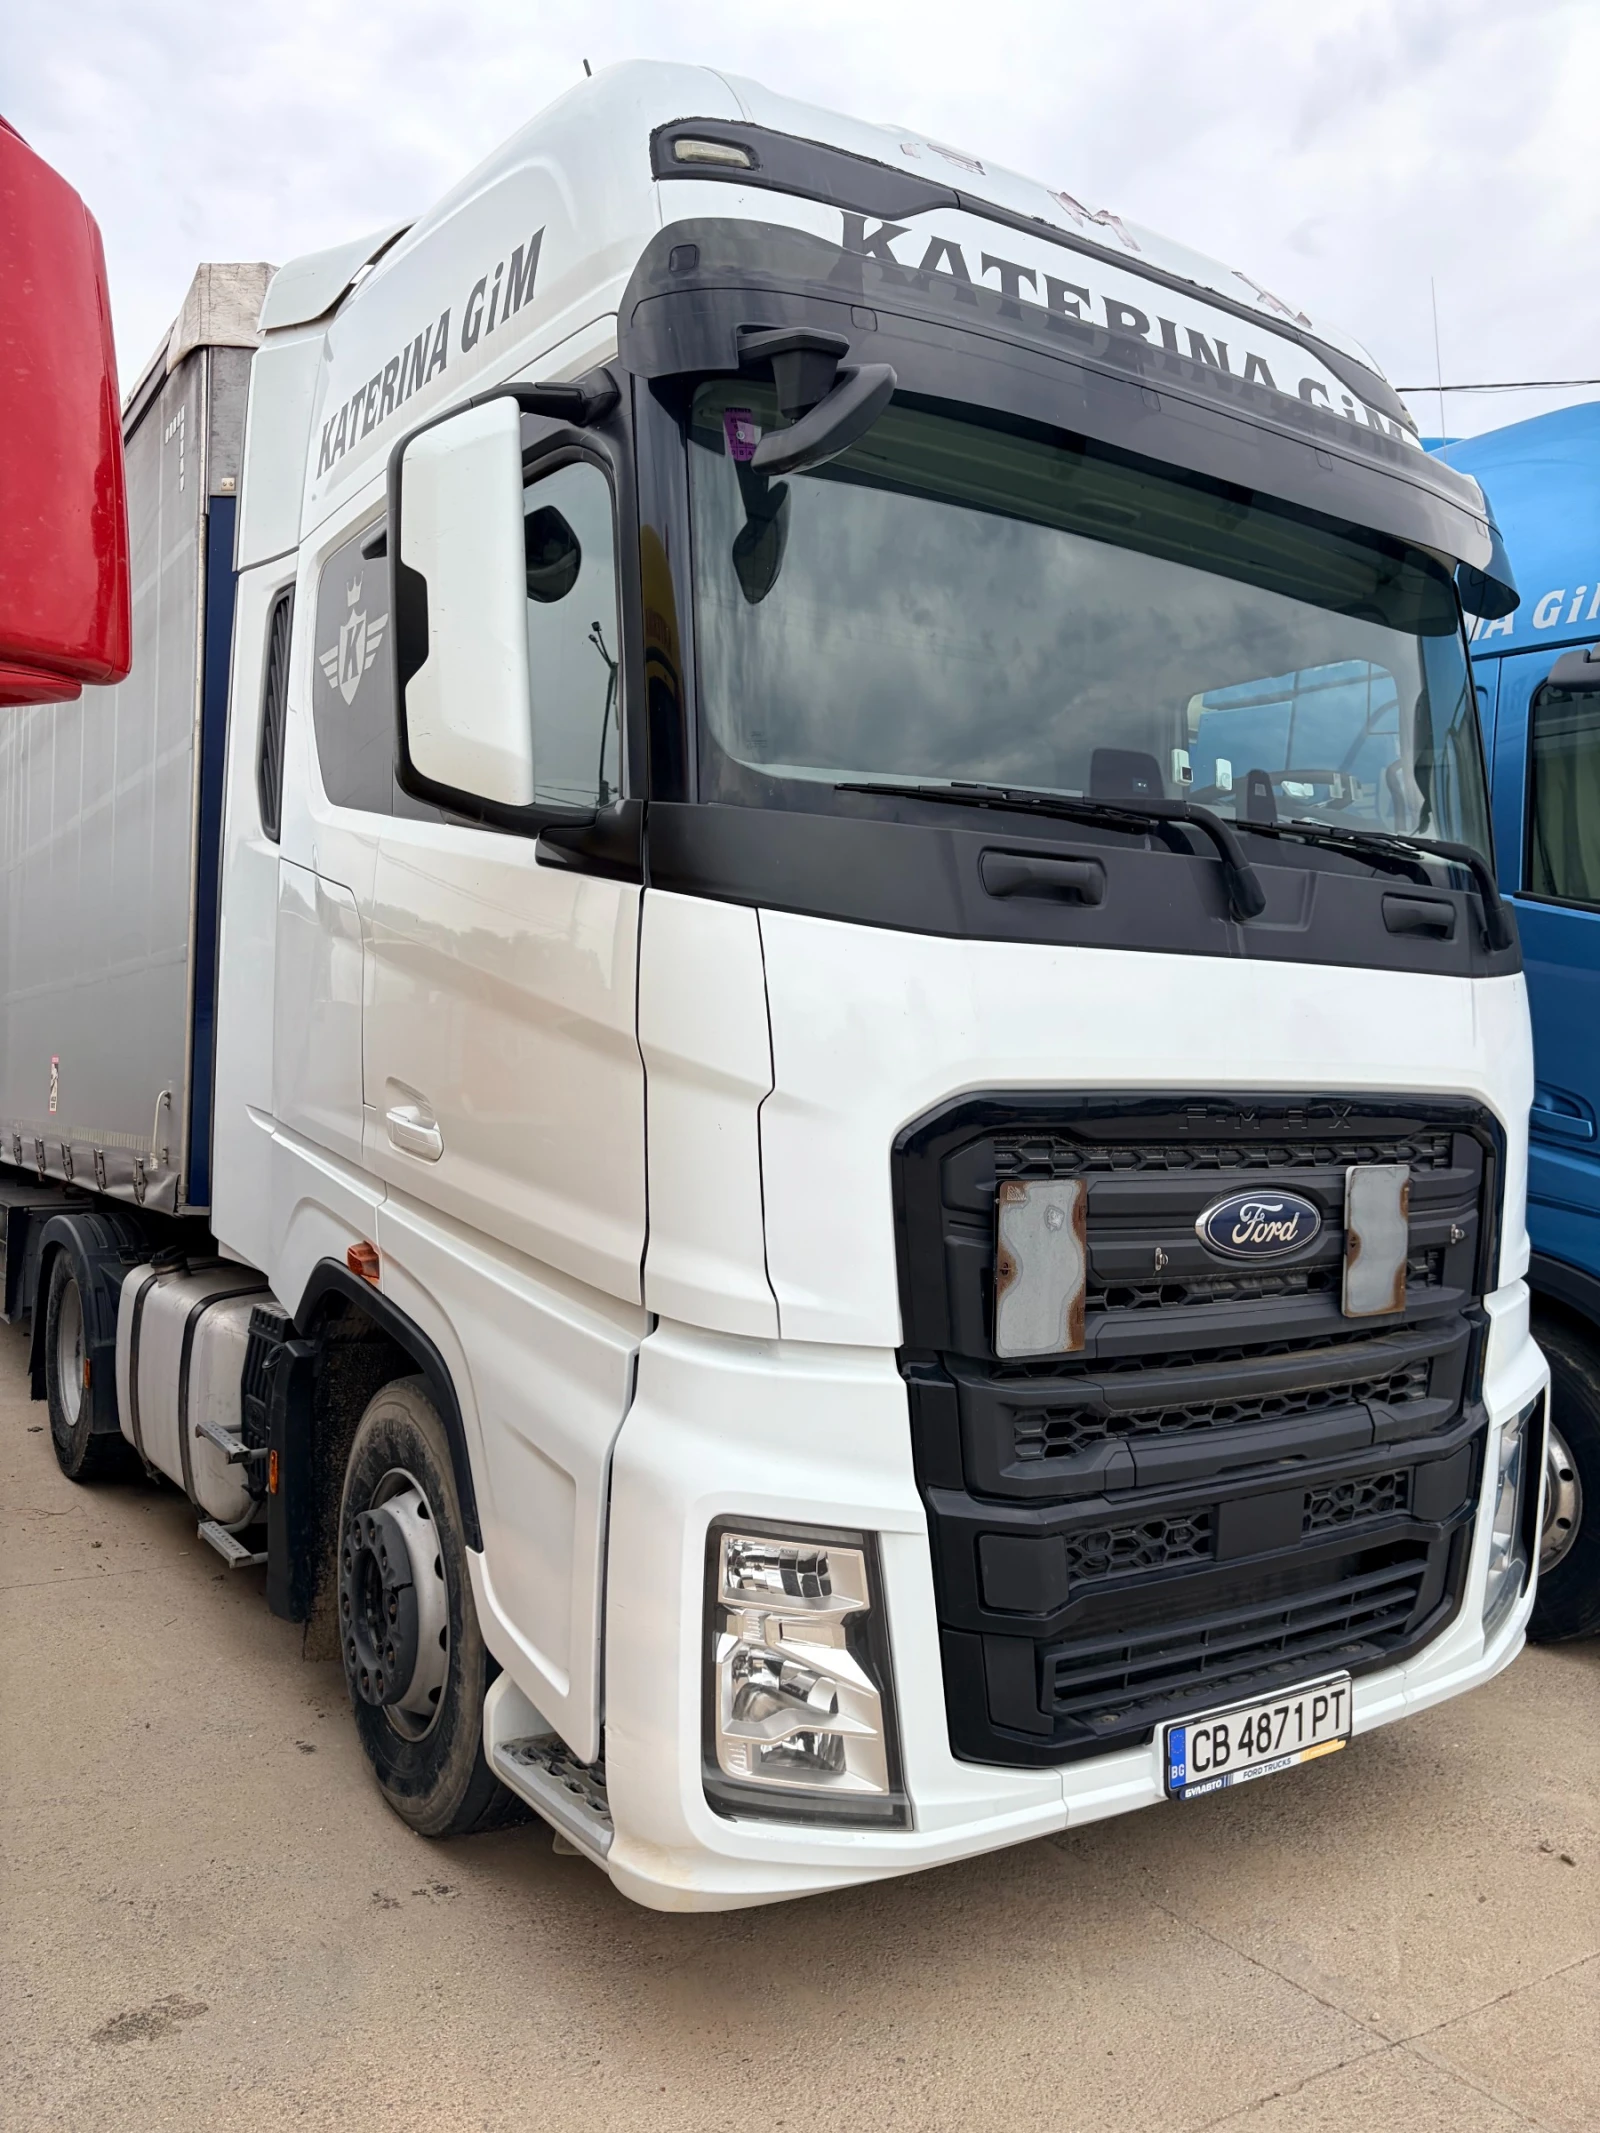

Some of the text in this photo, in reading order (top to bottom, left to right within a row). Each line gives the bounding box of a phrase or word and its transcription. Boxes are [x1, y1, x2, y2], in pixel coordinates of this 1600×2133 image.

[828, 209, 1292, 410] KATERINA
[316, 224, 547, 480] KATERINA GiM
[1231, 1202, 1300, 1244] Ford
[1192, 1688, 1346, 1773] CB 4871 PT
[1171, 1763, 1185, 1779] BG
[1242, 1757, 1292, 1779] FORD TRUCKS
